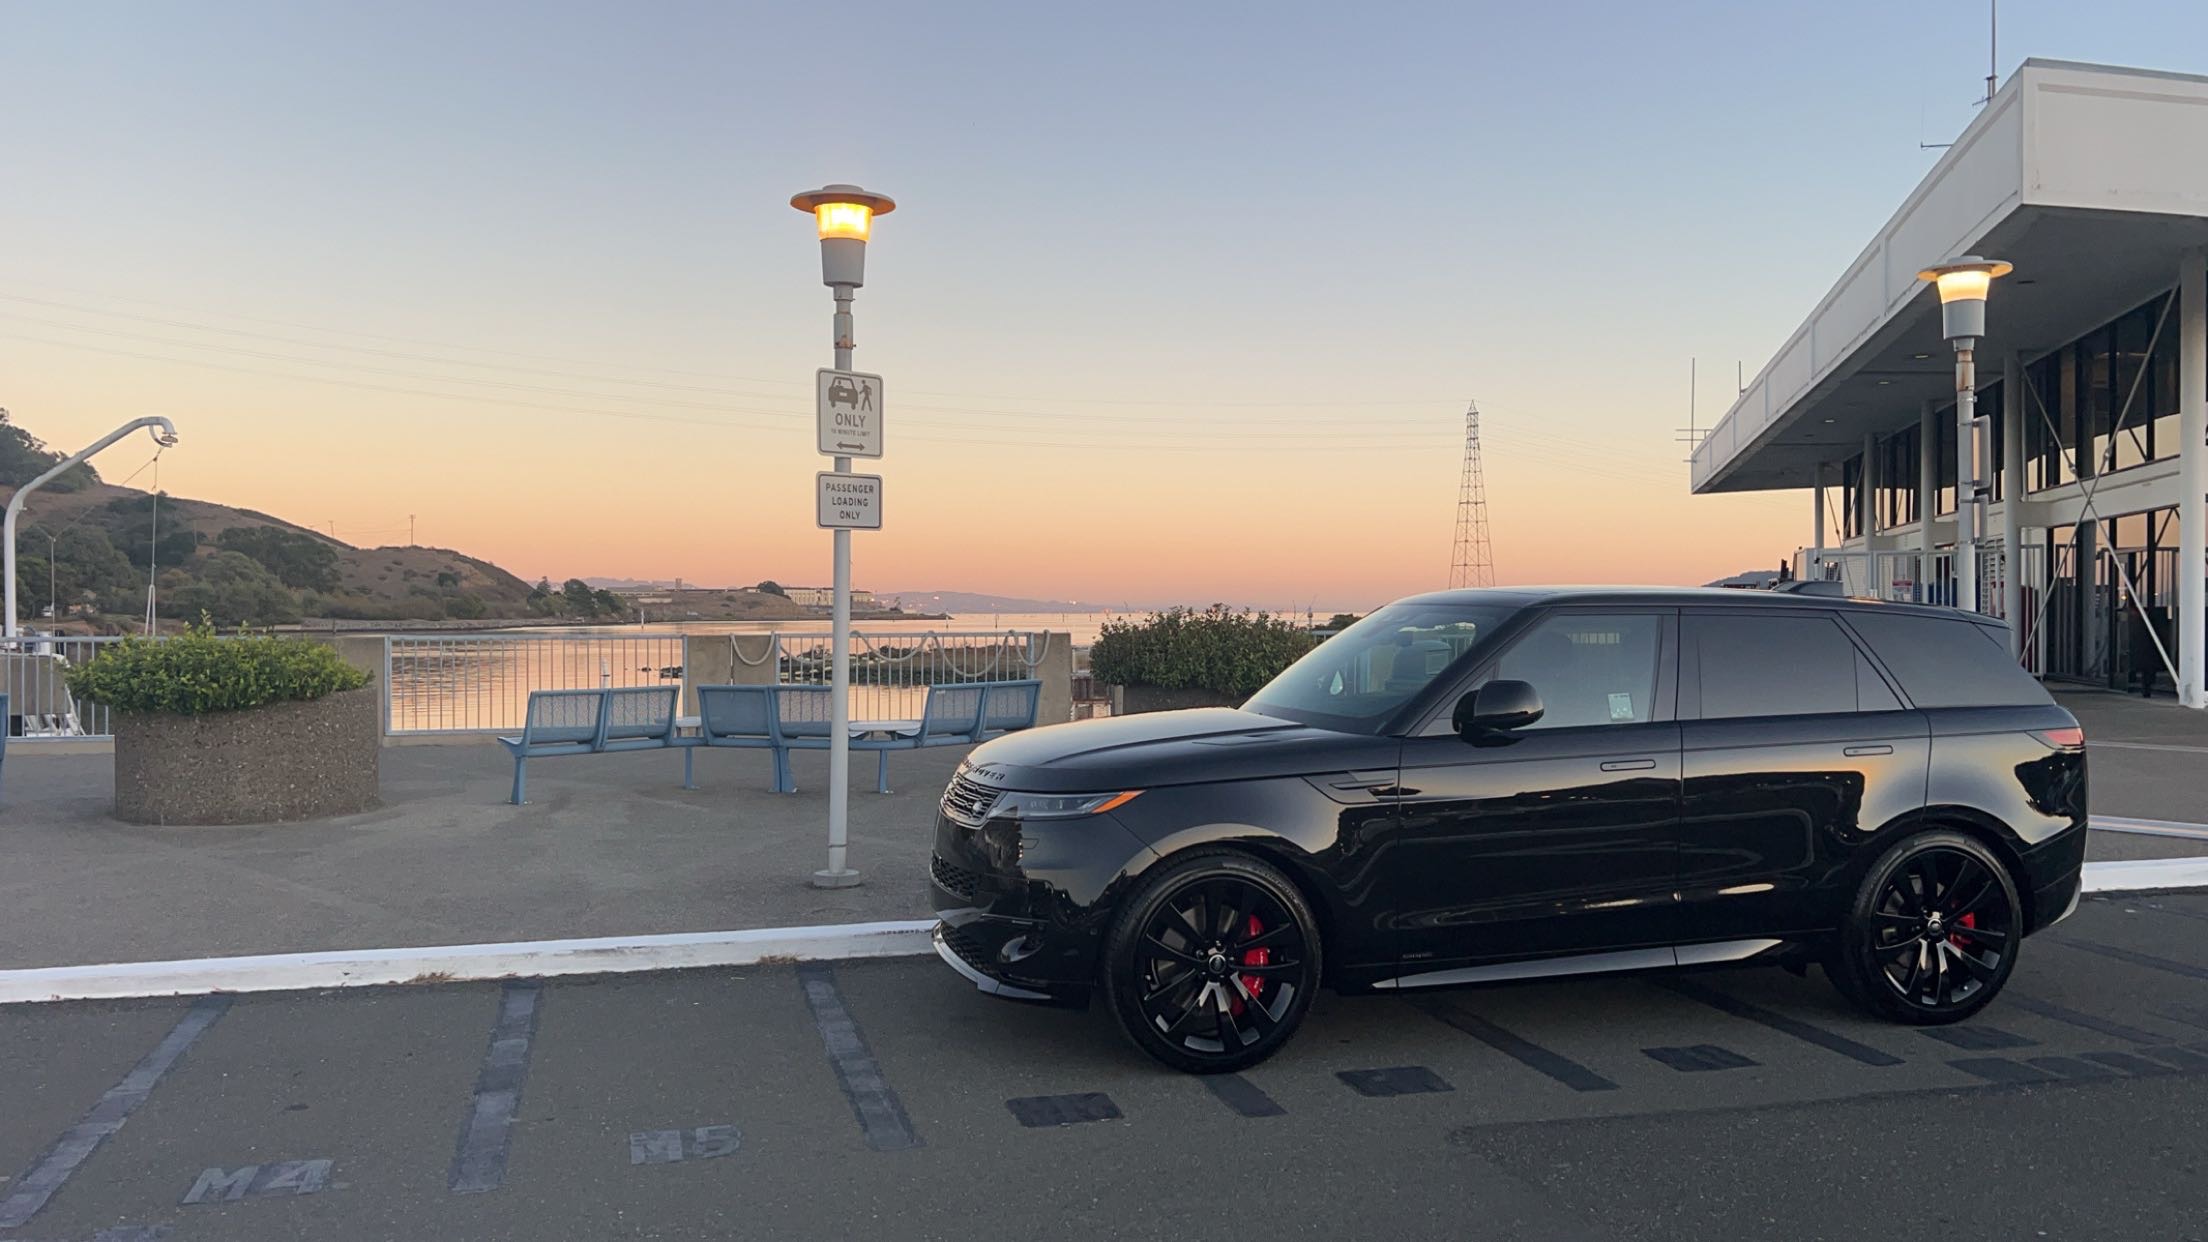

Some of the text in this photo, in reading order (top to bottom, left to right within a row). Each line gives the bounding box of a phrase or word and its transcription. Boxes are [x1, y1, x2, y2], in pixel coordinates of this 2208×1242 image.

[835, 412, 866, 428] ONLY
[825, 482, 874, 494] PASSENGER
[832, 496, 869, 507] LOADING
[839, 510, 861, 520] ONLY
[182, 1159, 335, 1204] M4
